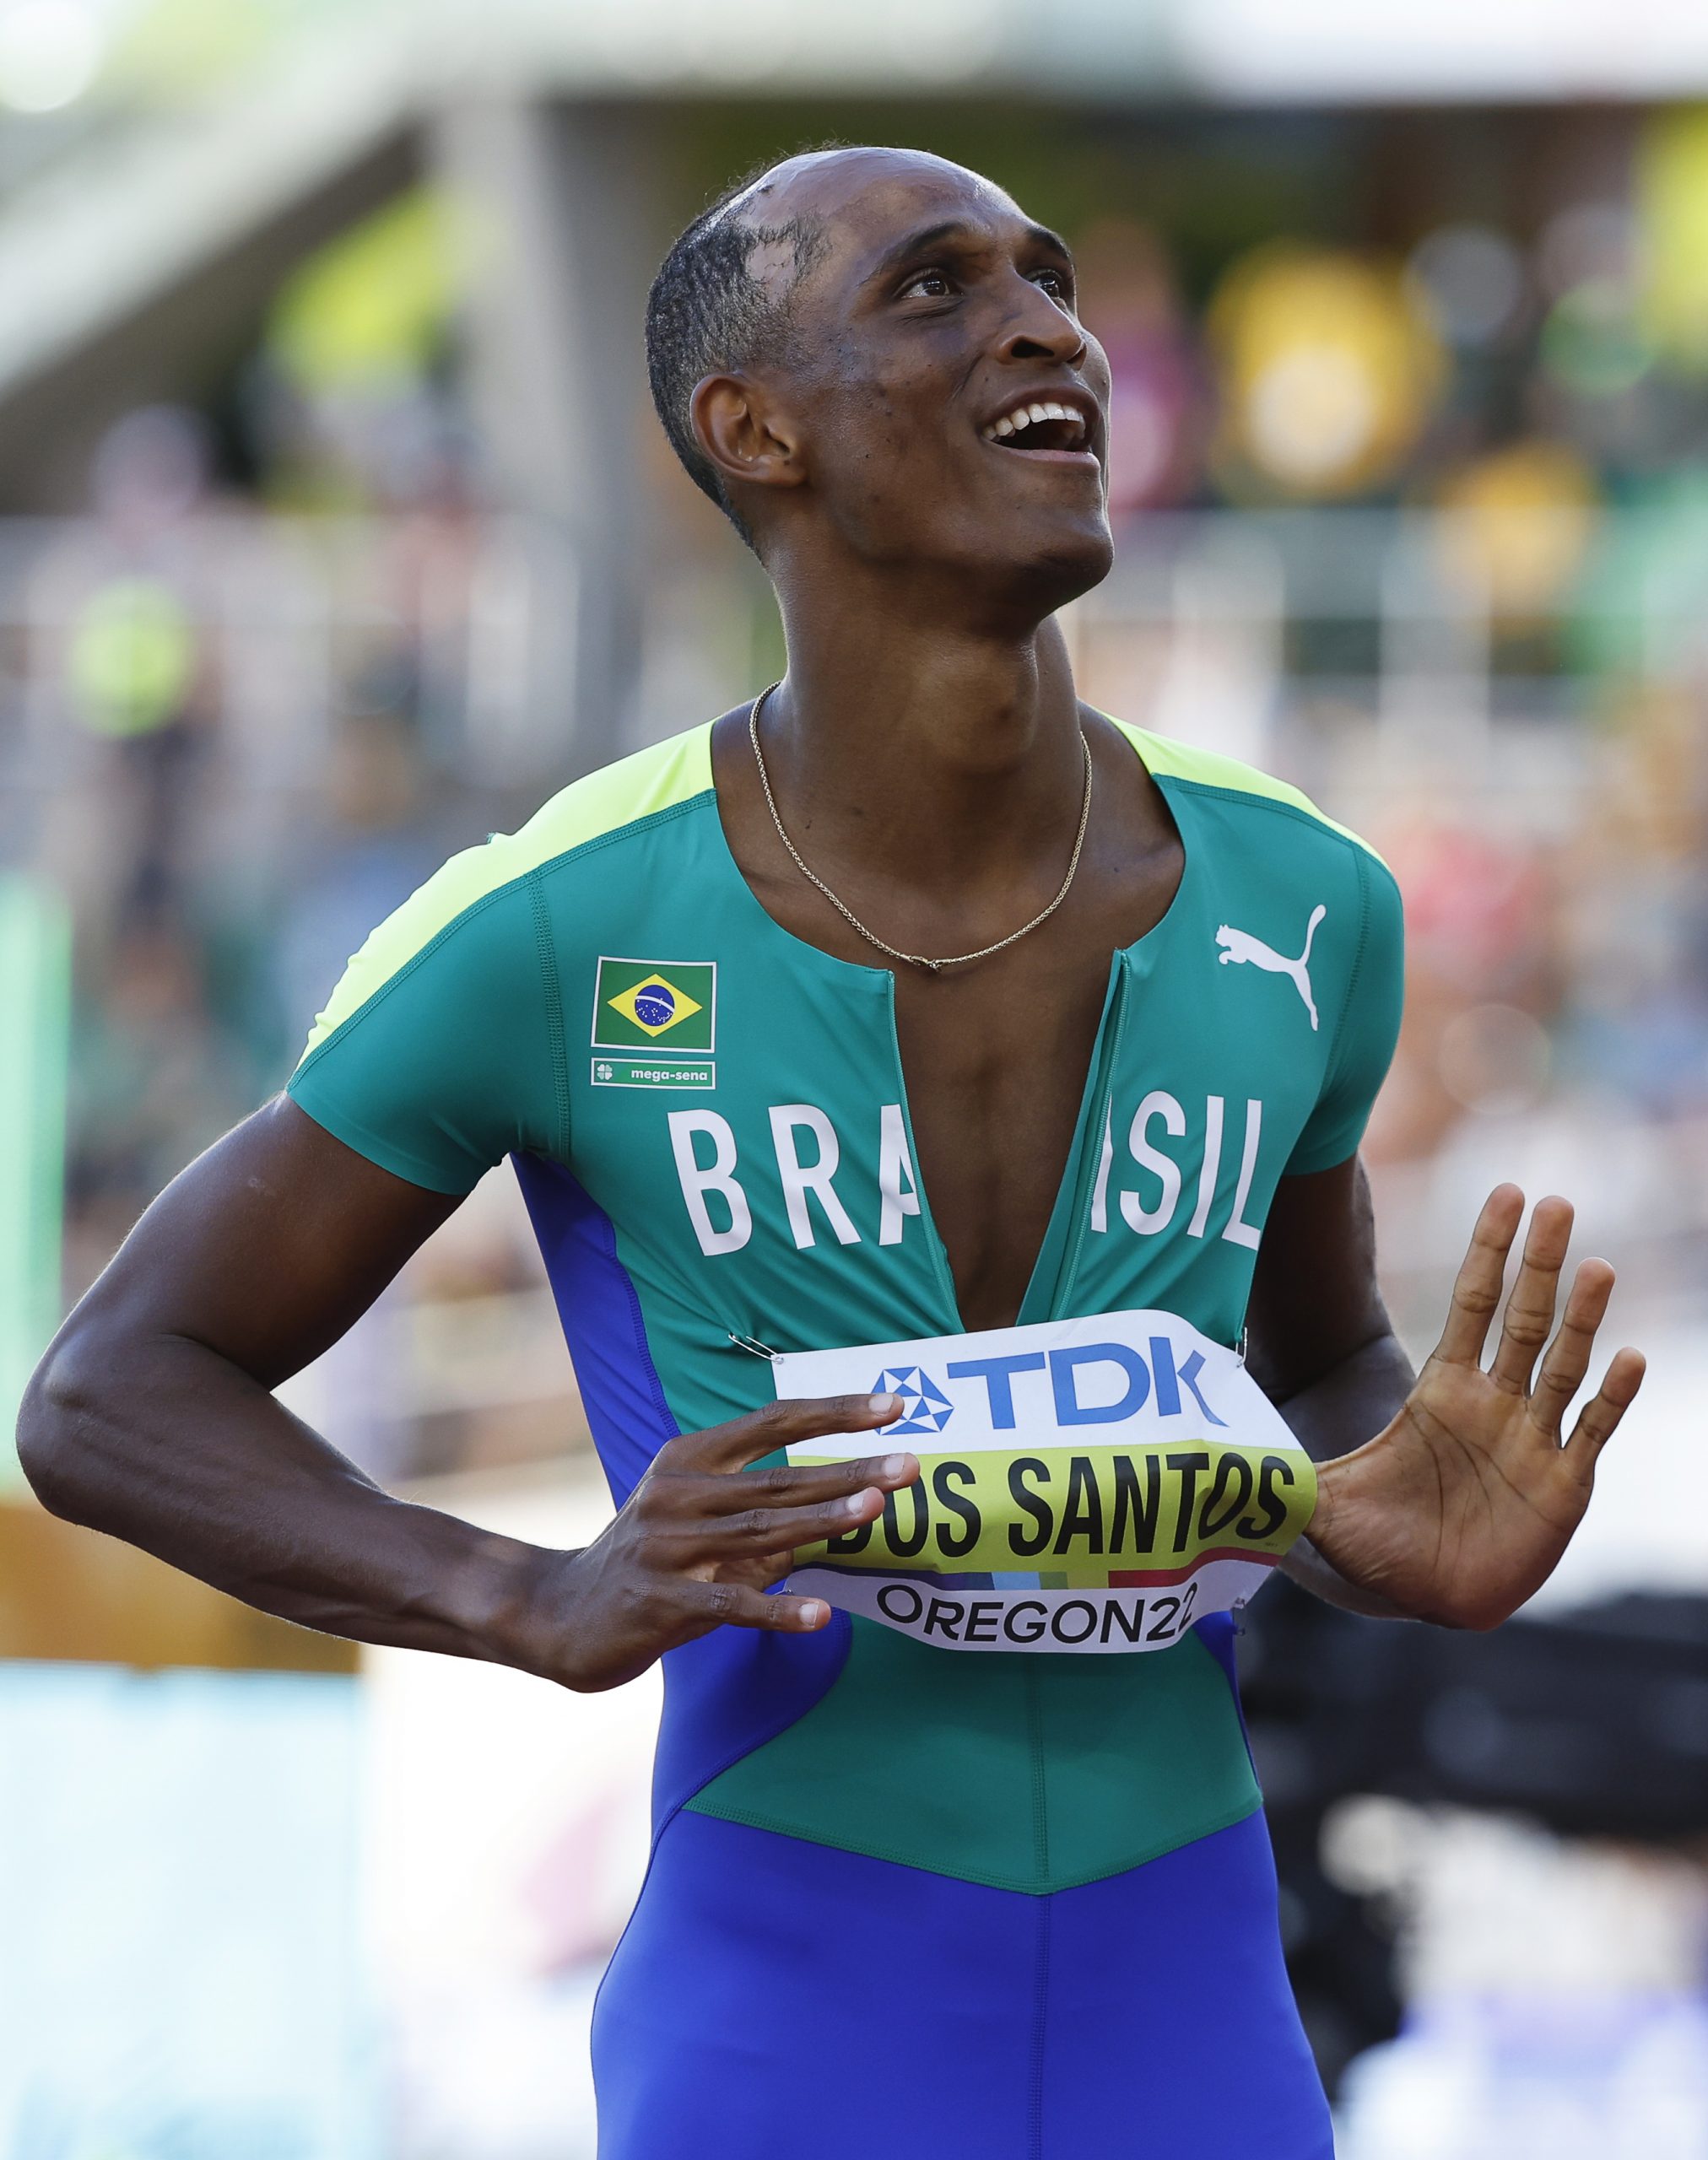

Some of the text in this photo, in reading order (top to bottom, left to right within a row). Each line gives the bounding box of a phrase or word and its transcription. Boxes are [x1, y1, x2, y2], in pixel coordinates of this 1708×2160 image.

[630, 1068, 708, 1082] mega-sena
[947, 1336, 1230, 1429] TDK
[1008, 1452, 1295, 1557] SANTOS
[876, 1582, 1197, 1644] OREGON22
